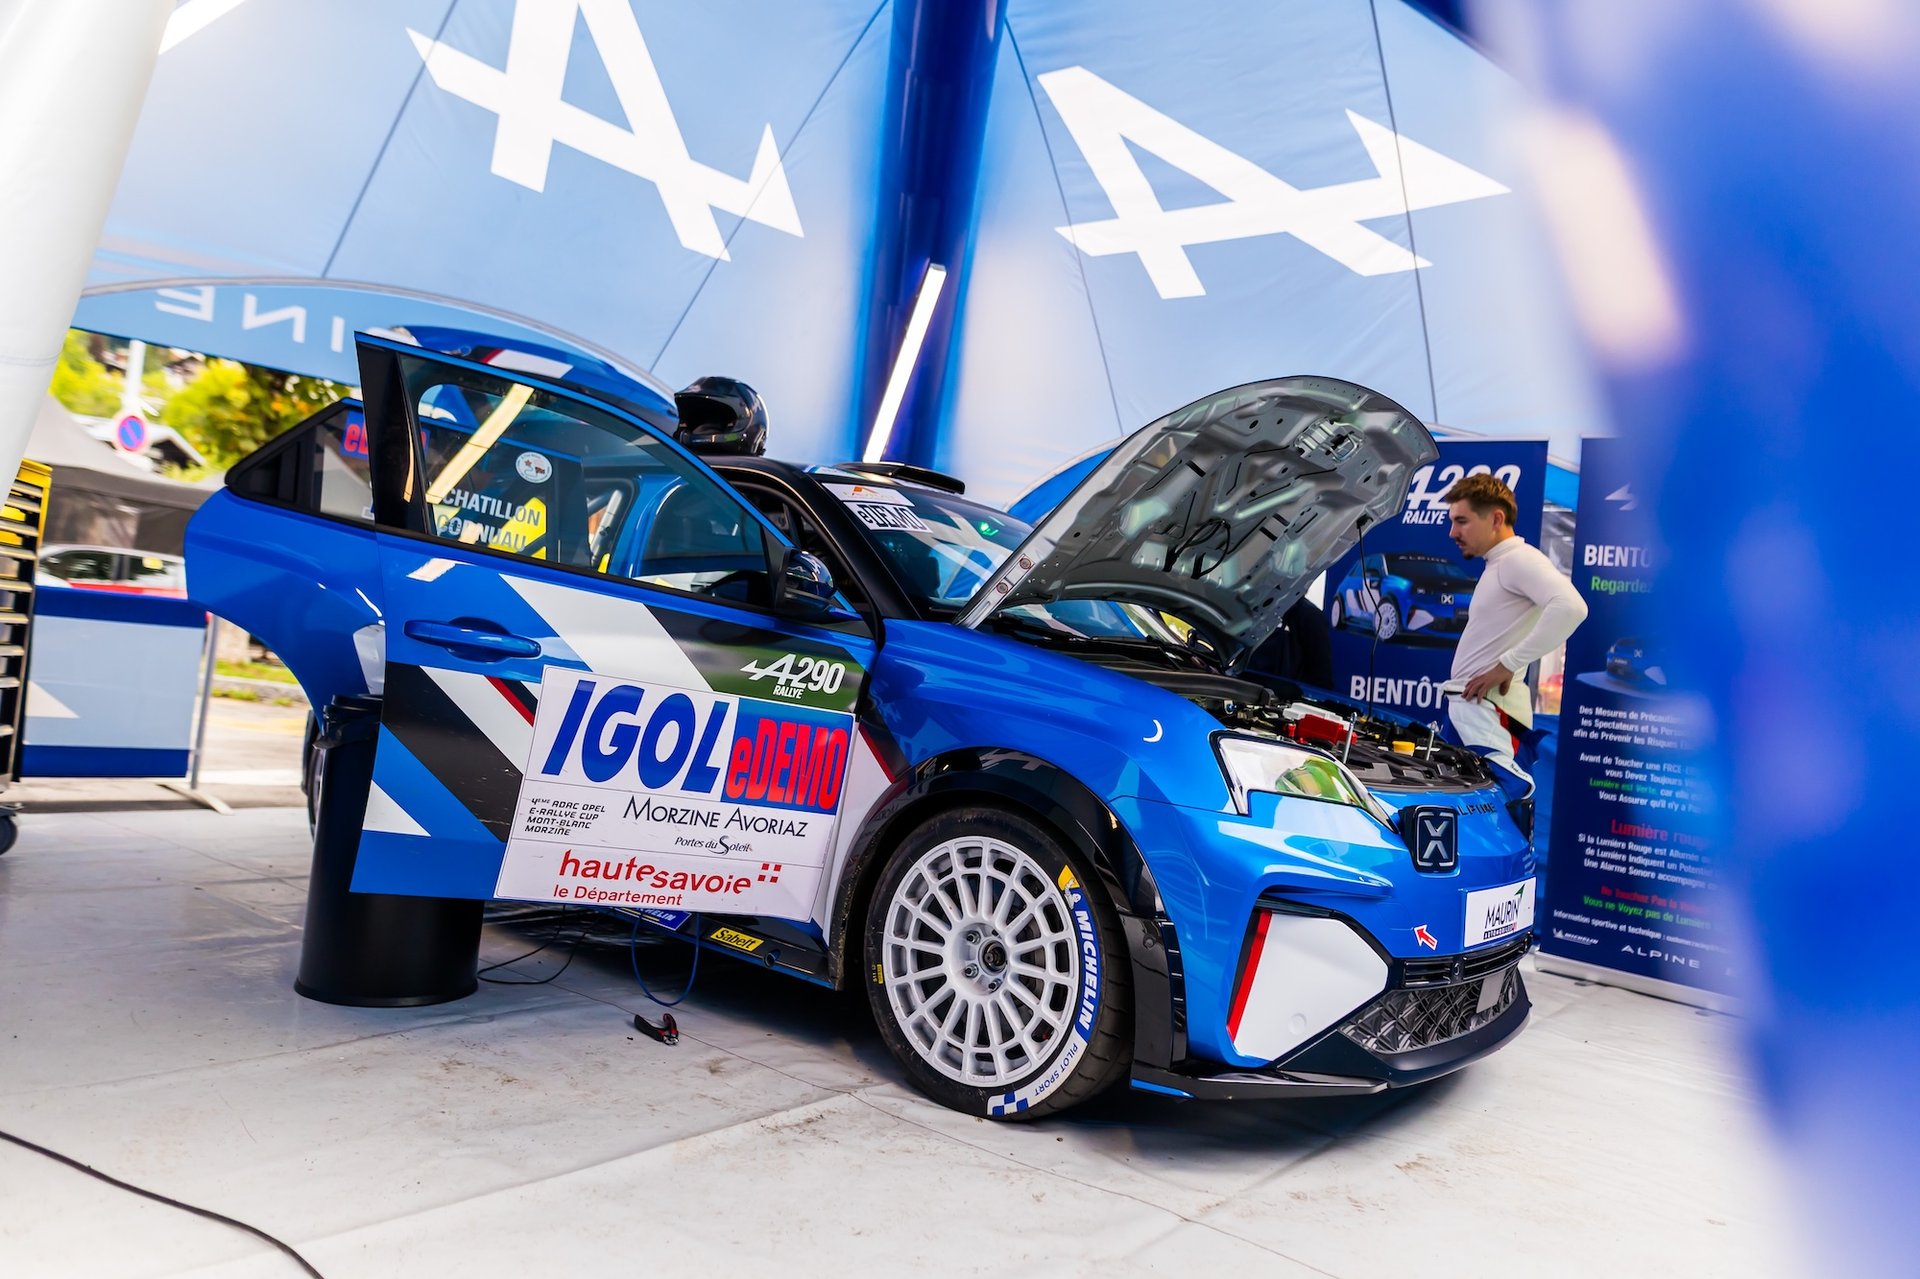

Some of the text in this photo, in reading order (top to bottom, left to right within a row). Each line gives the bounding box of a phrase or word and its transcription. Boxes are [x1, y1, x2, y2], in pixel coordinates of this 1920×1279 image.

[856, 504, 928, 530] eDEMO
[1402, 510, 1447, 525] RALLYE
[773, 685, 804, 699] RALLYE
[541, 679, 848, 809] IGOL eDEMO
[1589, 730, 1599, 740] de
[1579, 752, 1601, 763] Avant
[1603, 755, 1612, 764] de
[552, 800, 579, 810] ADAC
[582, 804, 605, 813] OPEL
[1599, 790, 1617, 801] Vous
[1619, 793, 1648, 805] Assurer
[529, 807, 599, 821] E-RALLYE CUP
[623, 796, 808, 837] MORZINE AVORIAZ
[1456, 802, 1497, 816] LPINE
[524, 825, 571, 836] MORZINE
[527, 816, 591, 829] MONT-BLANC
[675, 835, 752, 856] Portes du Soleil
[553, 884, 682, 906] le Département
[1485, 898, 1521, 929] MAURIN
[1583, 895, 1602, 908] Vous
[1618, 902, 1643, 916] Voyez
[716, 930, 756, 949] Sabelt
[1621, 944, 1700, 969] ALPINE
[1075, 910, 1097, 1030] MICHELIN
[1034, 1043, 1078, 1096] PILOT SPORT
